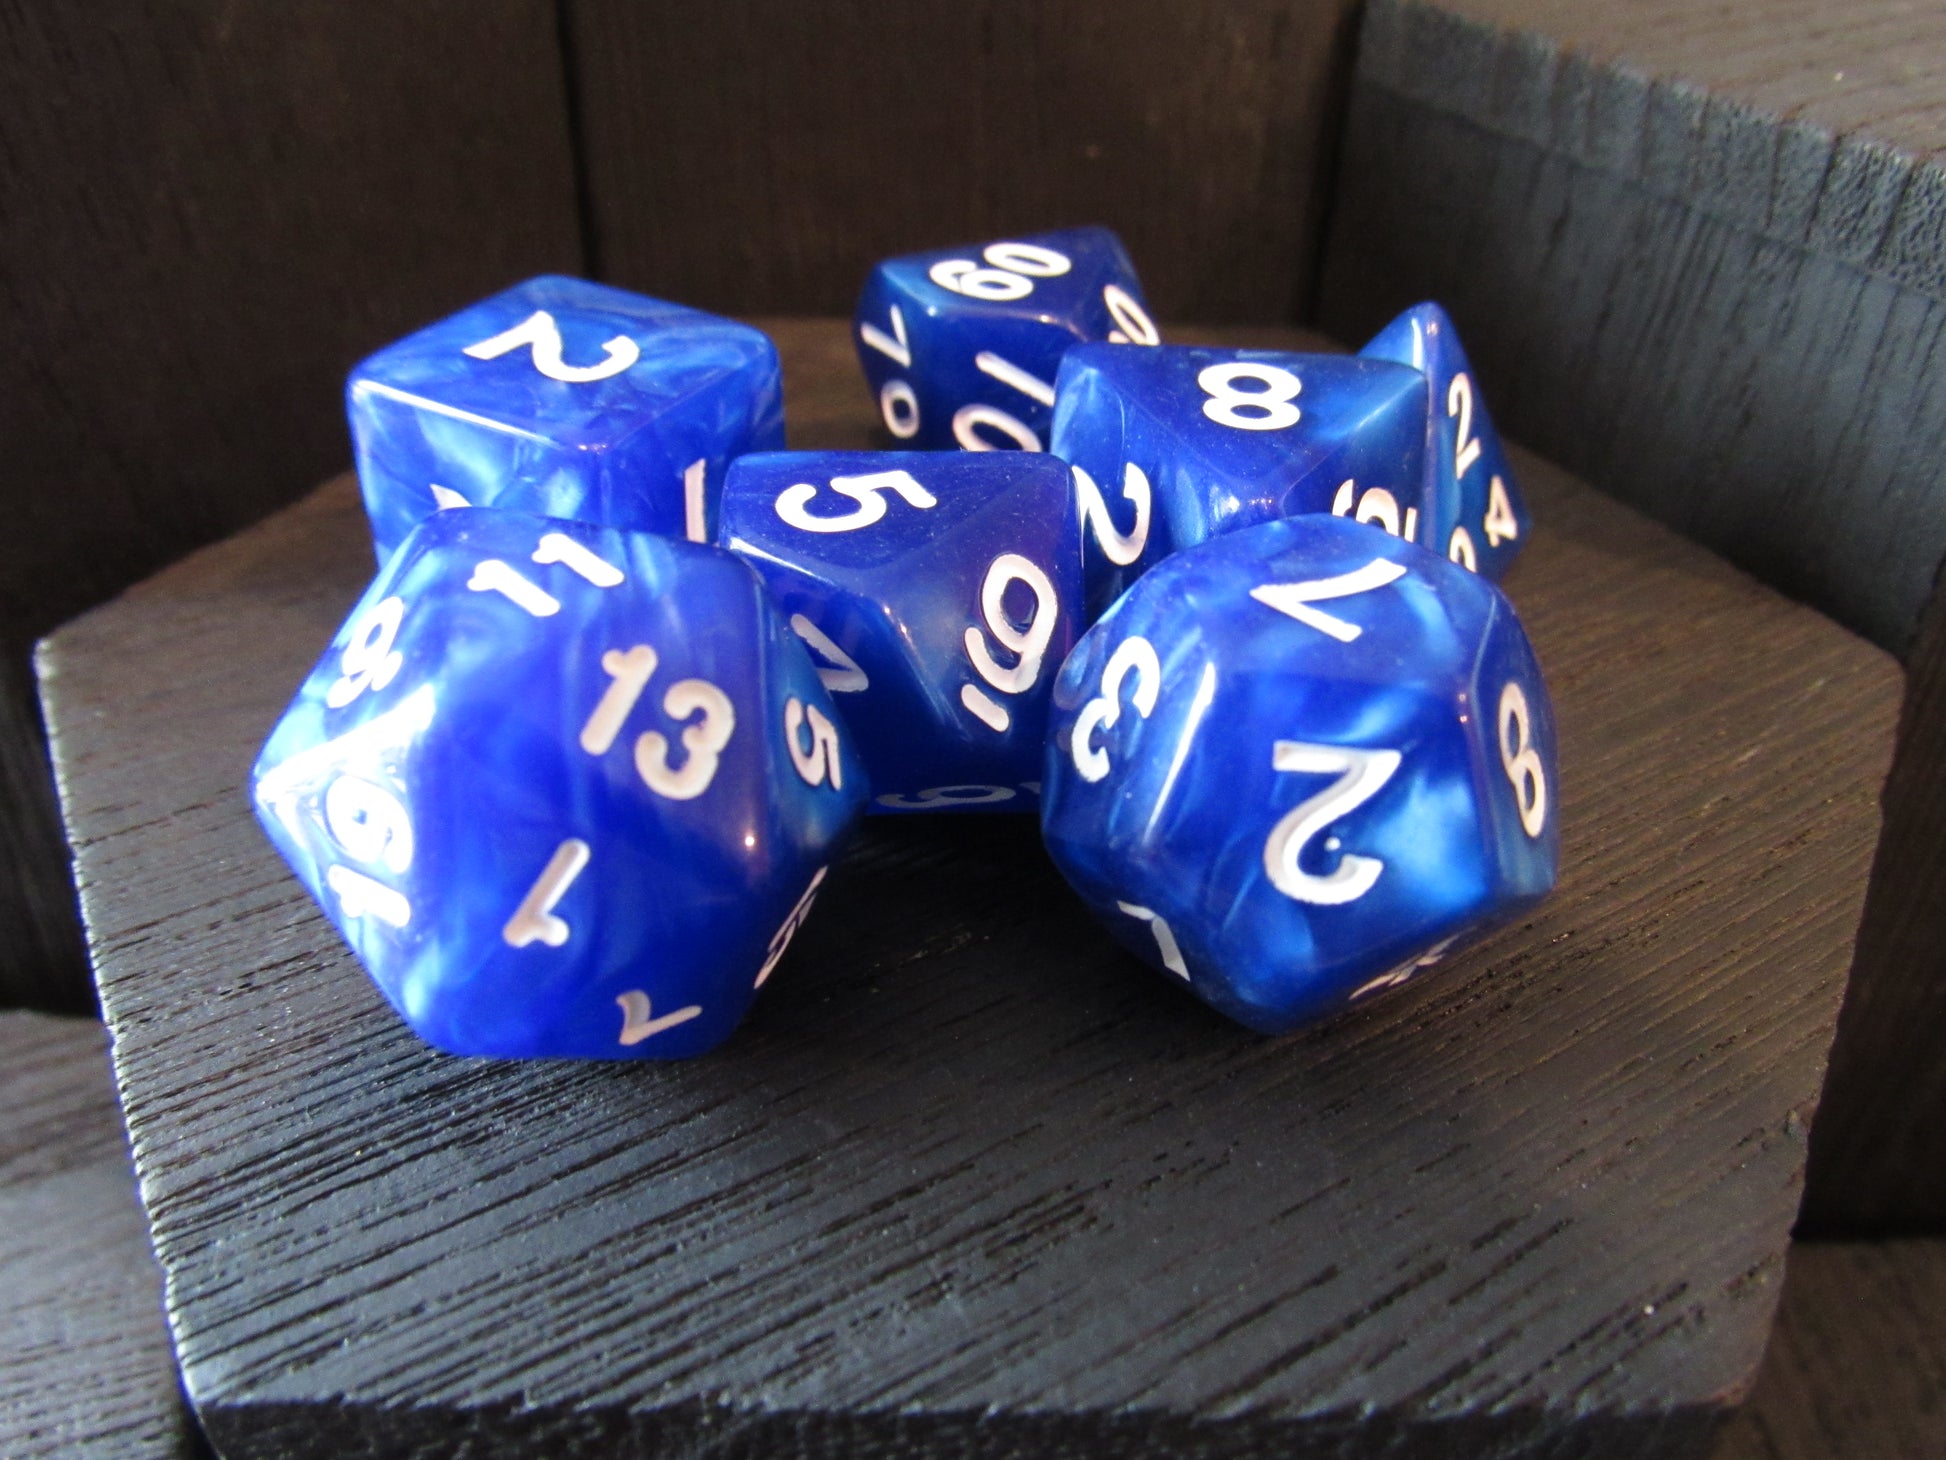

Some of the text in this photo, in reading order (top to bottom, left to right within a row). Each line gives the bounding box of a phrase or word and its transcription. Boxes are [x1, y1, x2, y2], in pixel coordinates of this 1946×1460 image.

[929, 241, 1071, 301] 60
[461, 310, 640, 383] 2
[860, 303, 920, 439] 70
[1198, 362, 1302, 430] 8
[1447, 372, 1481, 479] 2
[775, 470, 937, 533] 5
[1071, 461, 1151, 566] 2
[1484, 475, 1519, 548] 4
[467, 532, 624, 617] 11
[1250, 557, 1407, 643] 7
[580, 644, 735, 801] 13
[784, 697, 842, 791] 5
[1071, 636, 1160, 784] 3
[1498, 682, 1547, 839] 8
[1264, 739, 1402, 906] 2
[502, 837, 591, 948] 1
